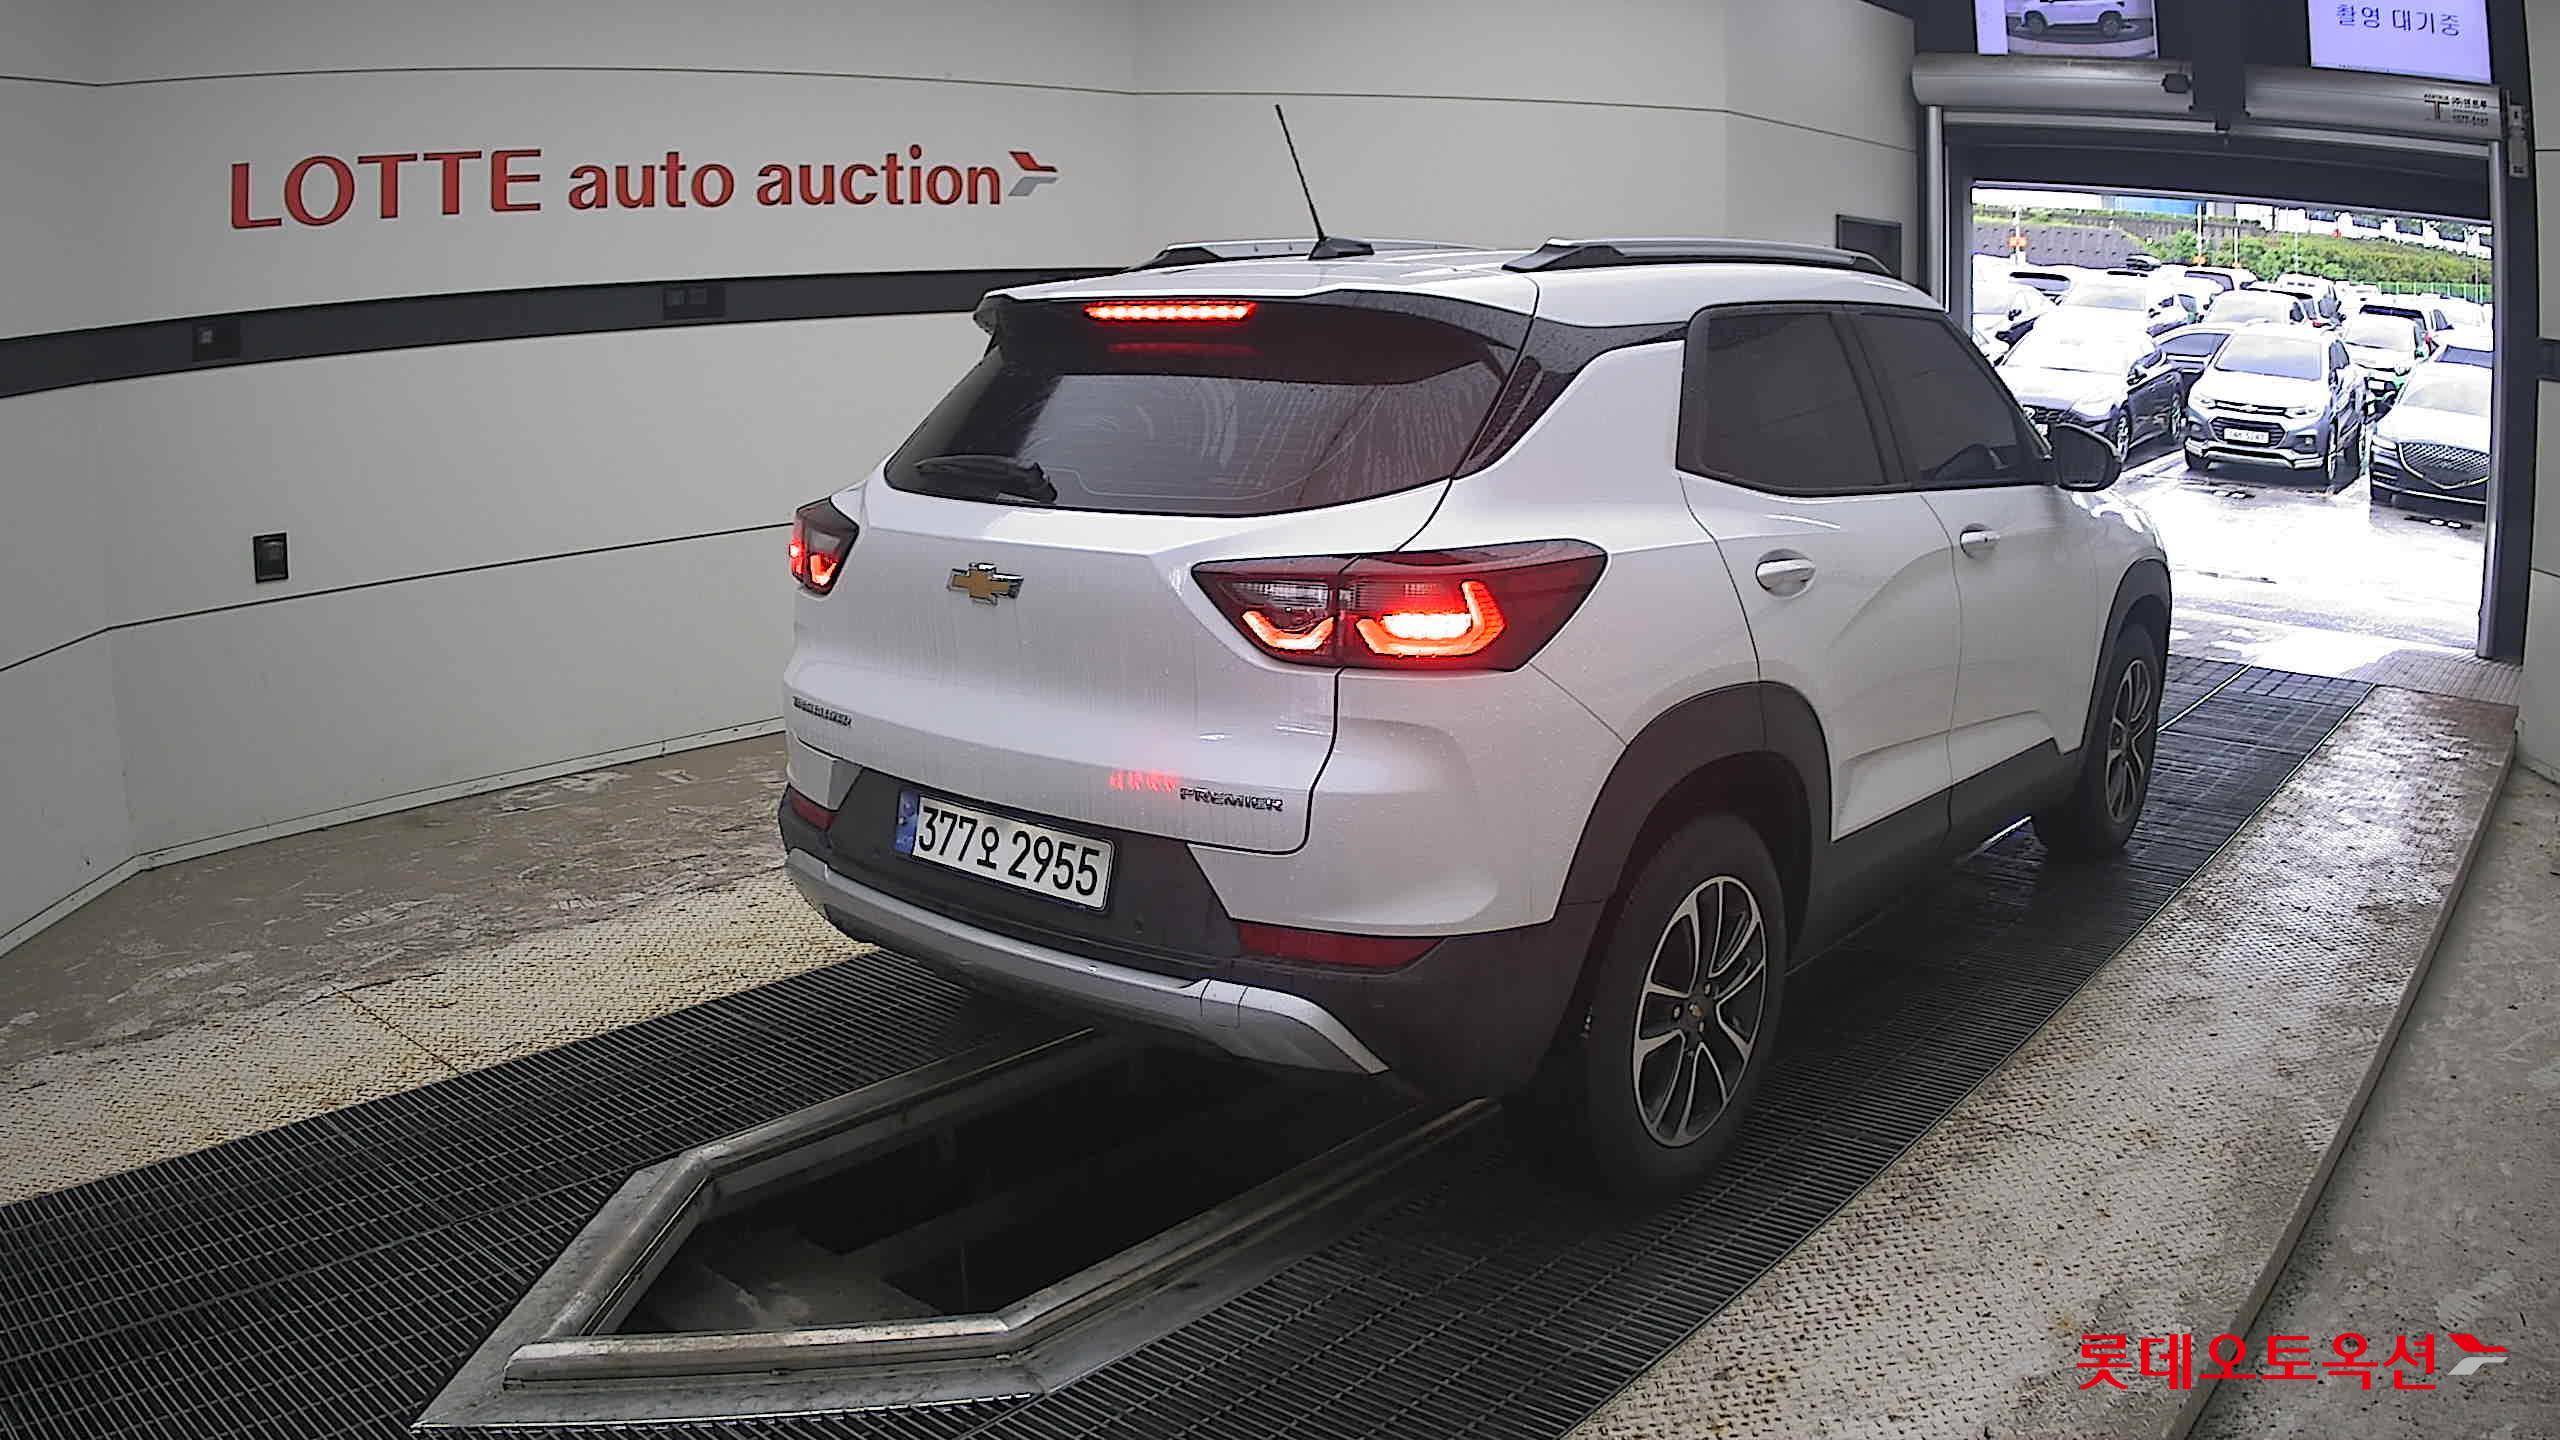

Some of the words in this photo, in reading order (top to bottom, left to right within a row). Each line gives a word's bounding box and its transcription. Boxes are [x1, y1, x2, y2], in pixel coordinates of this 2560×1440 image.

[2391, 8, 2460, 37] 대기중
[231, 148, 542, 229] LOTTE
[568, 152, 736, 209] auto
[756, 145, 1001, 206] auction
[1179, 786, 1285, 812] PREMIER
[918, 805, 1000, 870] 377오
[1007, 829, 1100, 897] 2955
